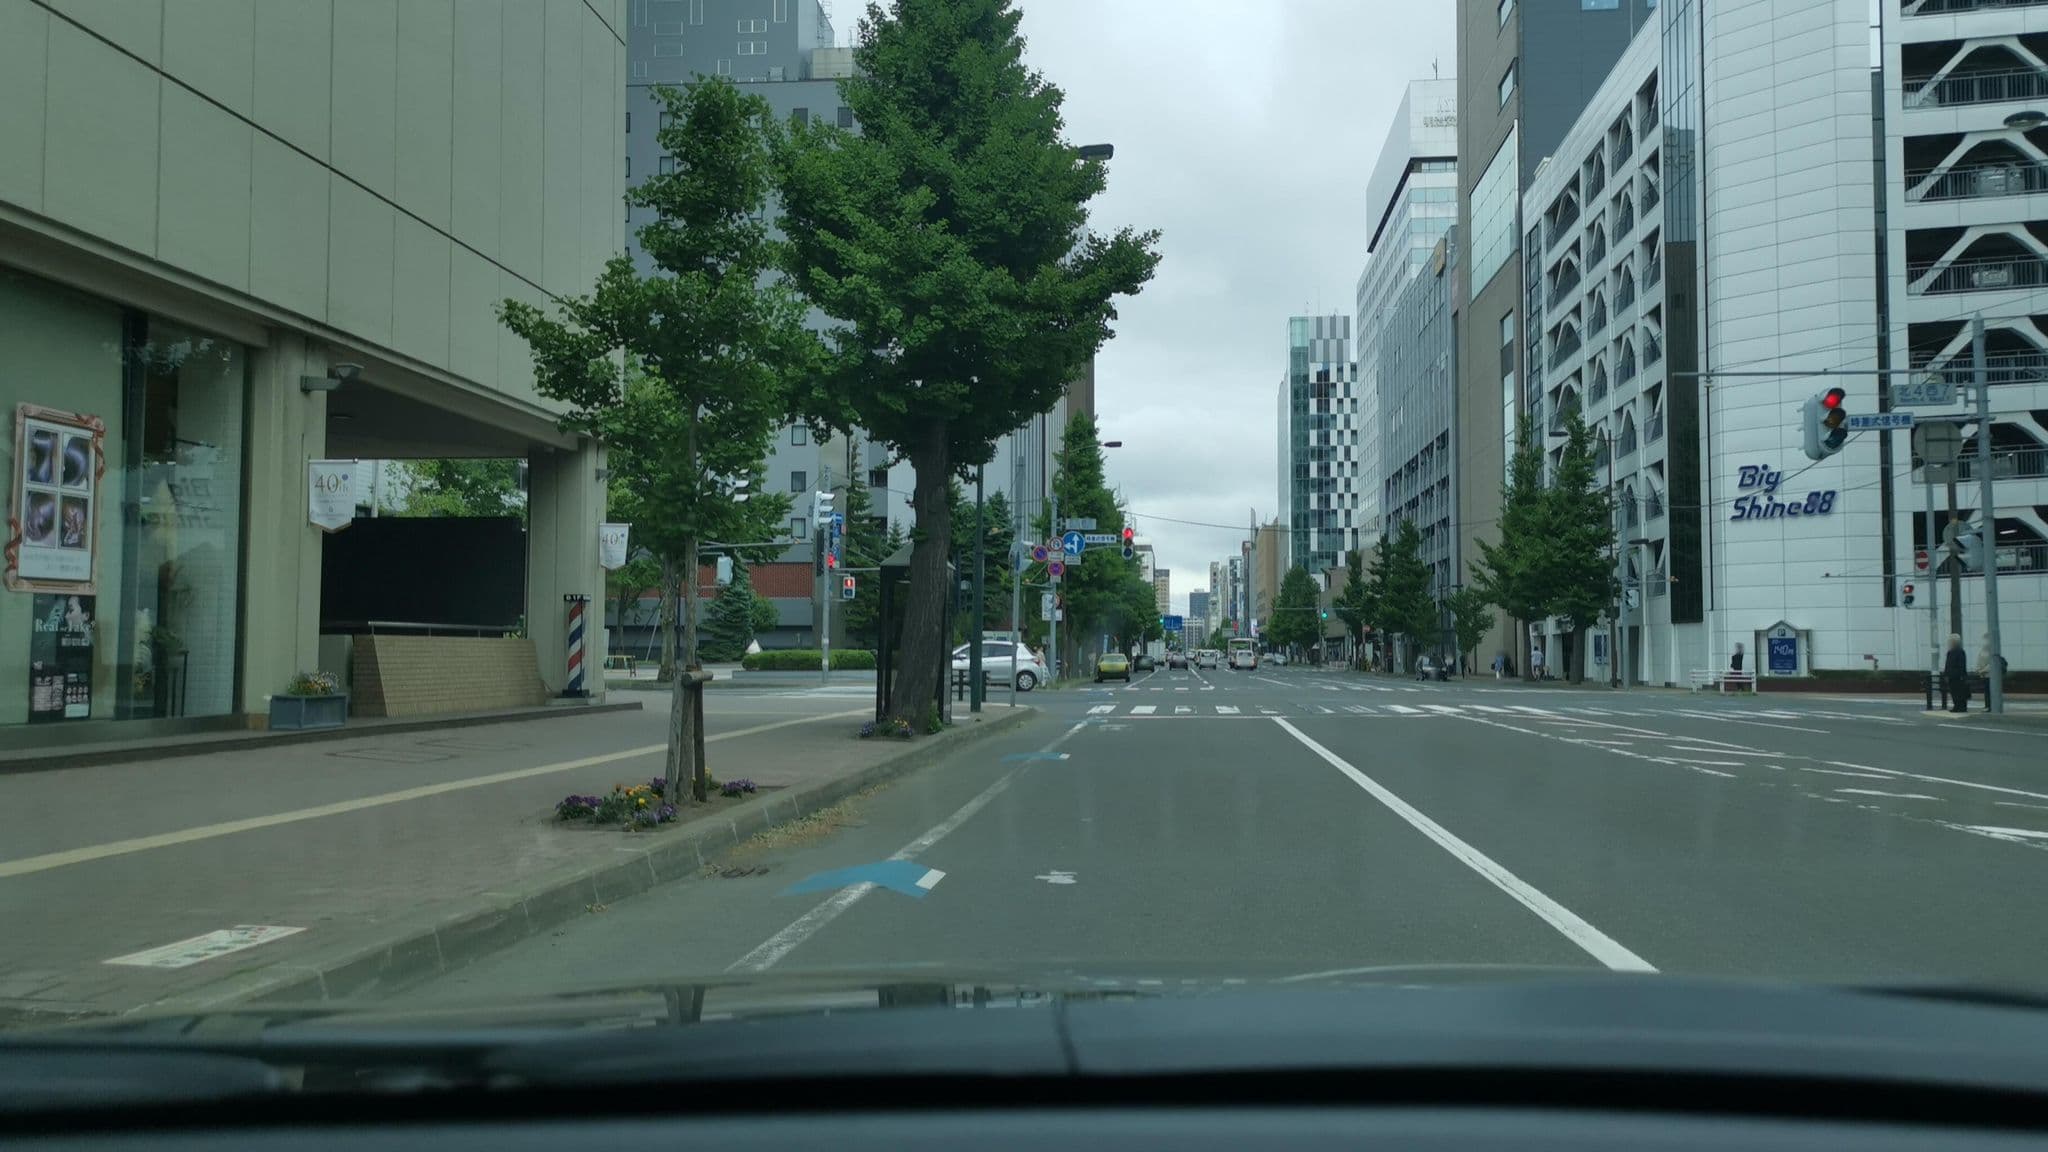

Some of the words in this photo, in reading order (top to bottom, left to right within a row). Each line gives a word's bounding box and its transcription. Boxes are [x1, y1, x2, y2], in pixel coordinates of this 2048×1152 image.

[1738, 464, 1781, 493] Big
[1729, 490, 1837, 521] Shine88
[35, 618, 59, 632] Real
